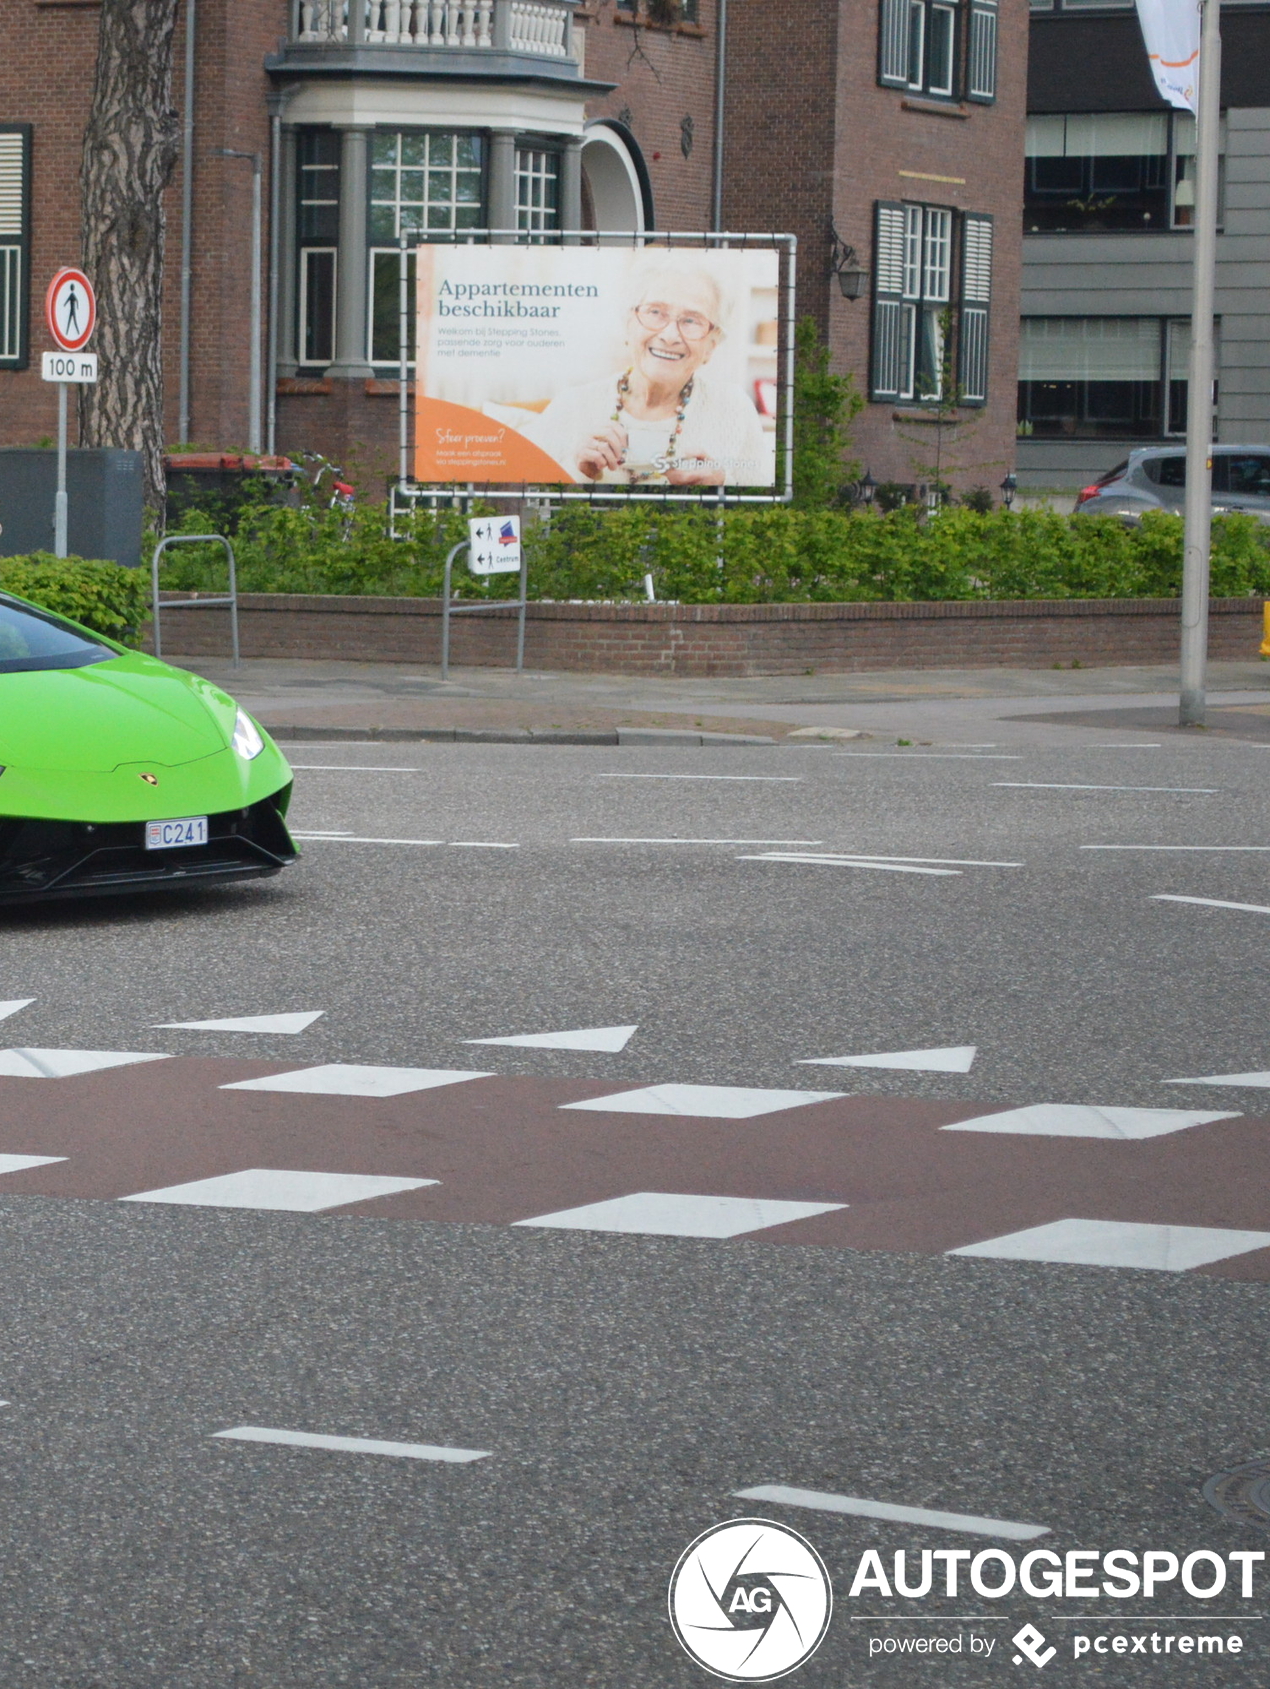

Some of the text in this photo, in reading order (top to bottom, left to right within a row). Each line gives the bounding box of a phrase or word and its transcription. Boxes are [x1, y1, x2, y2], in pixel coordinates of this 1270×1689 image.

[438, 279, 599, 300] Appartementen
[438, 300, 561, 318] beschikbaar
[438, 327, 473, 336] Welkom
[475, 327, 487, 338] bij
[487, 327, 528, 338] Stepping
[437, 338, 481, 348] passende
[483, 339, 503, 348] zorg
[527, 339, 566, 348] ouderen
[437, 349, 501, 358] met dementie
[50, 358, 92, 377] 100 m
[435, 428, 463, 444] Sfeer
[672, 457, 759, 470] Stepping Stones
[163, 821, 203, 844] C241
